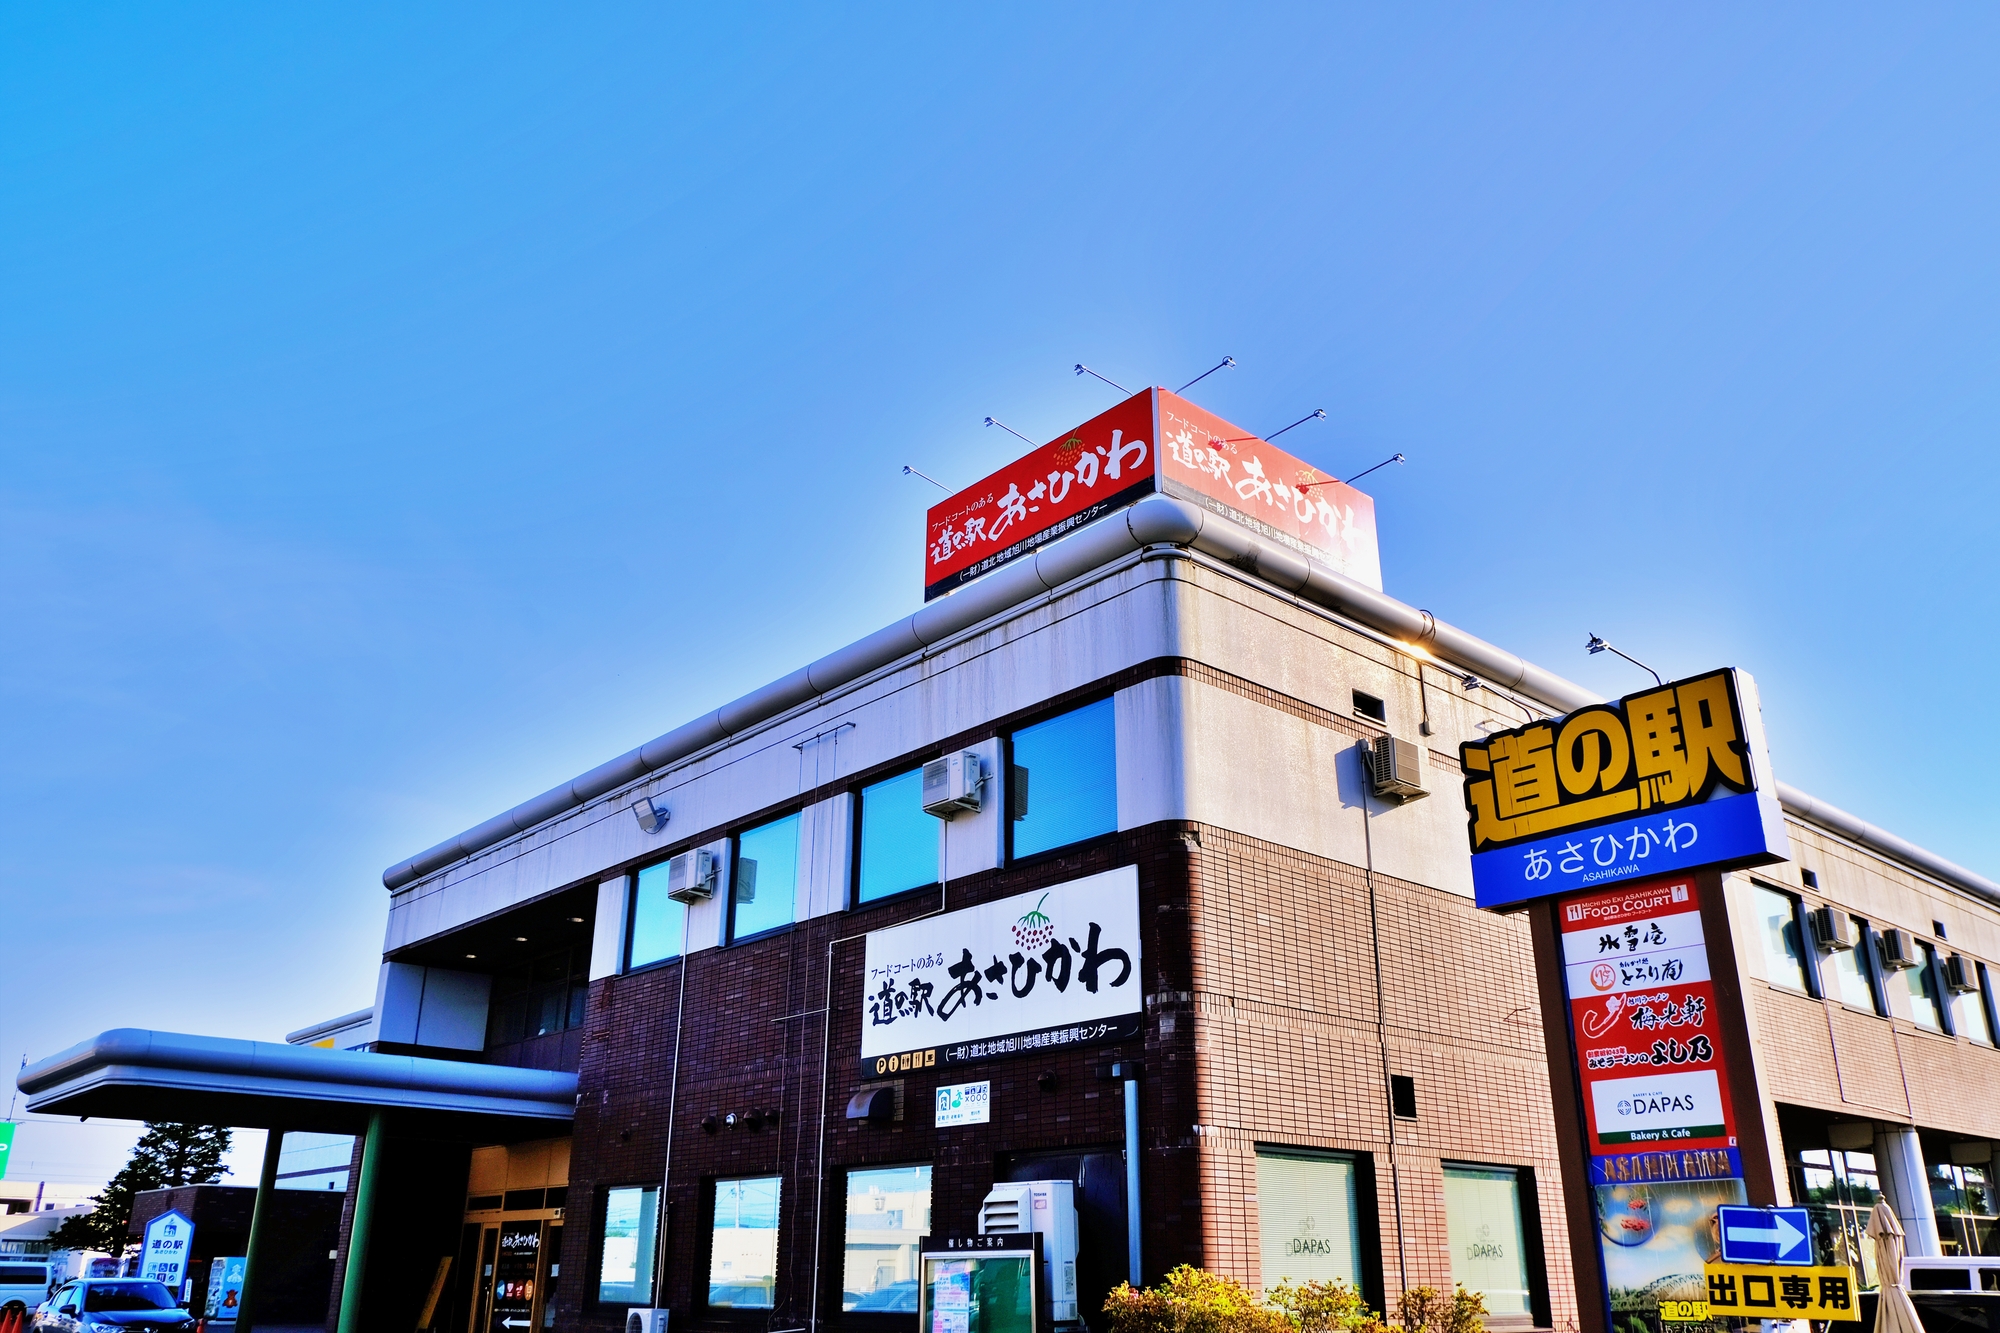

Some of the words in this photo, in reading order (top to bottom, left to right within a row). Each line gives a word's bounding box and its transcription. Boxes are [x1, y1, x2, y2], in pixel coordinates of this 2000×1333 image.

[1166, 428, 1233, 489] 道の駅
[930, 516, 987, 565] 道の駅
[988, 428, 1147, 541] あさひかわ
[932, 492, 994, 532] フードコートのある
[1464, 673, 1746, 848] 道の駅
[1523, 817, 1698, 881] あさひかわ
[1582, 864, 1640, 883] ASAHIKAWA
[1582, 904, 1620, 919] FOOD
[1623, 895, 1671, 912] COURT
[1625, 887, 1670, 901] ASAHIKAWA
[868, 977, 935, 1026] 道の駅
[936, 922, 1132, 1021] あさひかわ
[871, 952, 944, 980] フードコートのある
[1629, 995, 1706, 1030] 梅光軒
[945, 1024, 1118, 1062] (一財)道北地域旭川地場産業振興センター
[1588, 1054, 1649, 1069] みそラーメンの
[1650, 1034, 1714, 1066] よし乃
[1633, 1095, 1694, 1114] DAPAS
[1630, 1131, 1660, 1141] Bakery
[1662, 1130, 1669, 1138] &
[1671, 1128, 1691, 1138] Cafe
[152, 1239, 183, 1250] 道の駅
[948, 1237, 1004, 1248] 催し物ご案内
[1293, 1238, 1330, 1254] DAPAS
[1473, 1243, 1503, 1258] DAPAS
[1707, 1273, 1851, 1311] 出口専用
